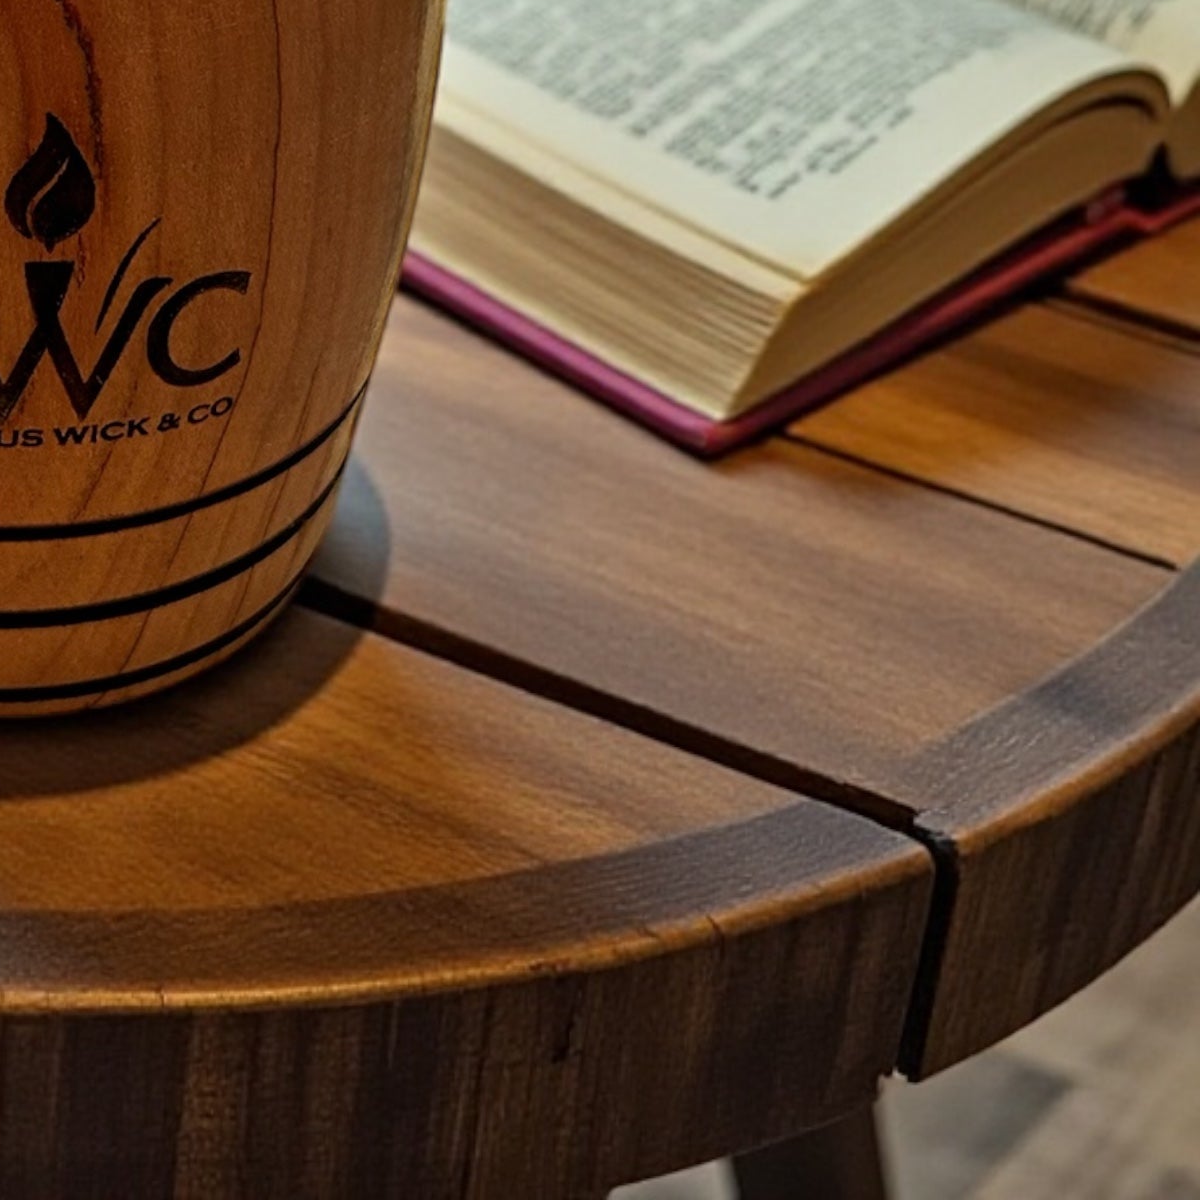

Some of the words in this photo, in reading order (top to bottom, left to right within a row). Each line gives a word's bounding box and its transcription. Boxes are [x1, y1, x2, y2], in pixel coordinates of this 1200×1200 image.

[53, 417, 150, 446] WICK
[156, 412, 182, 432] &
[186, 396, 234, 425] CO
